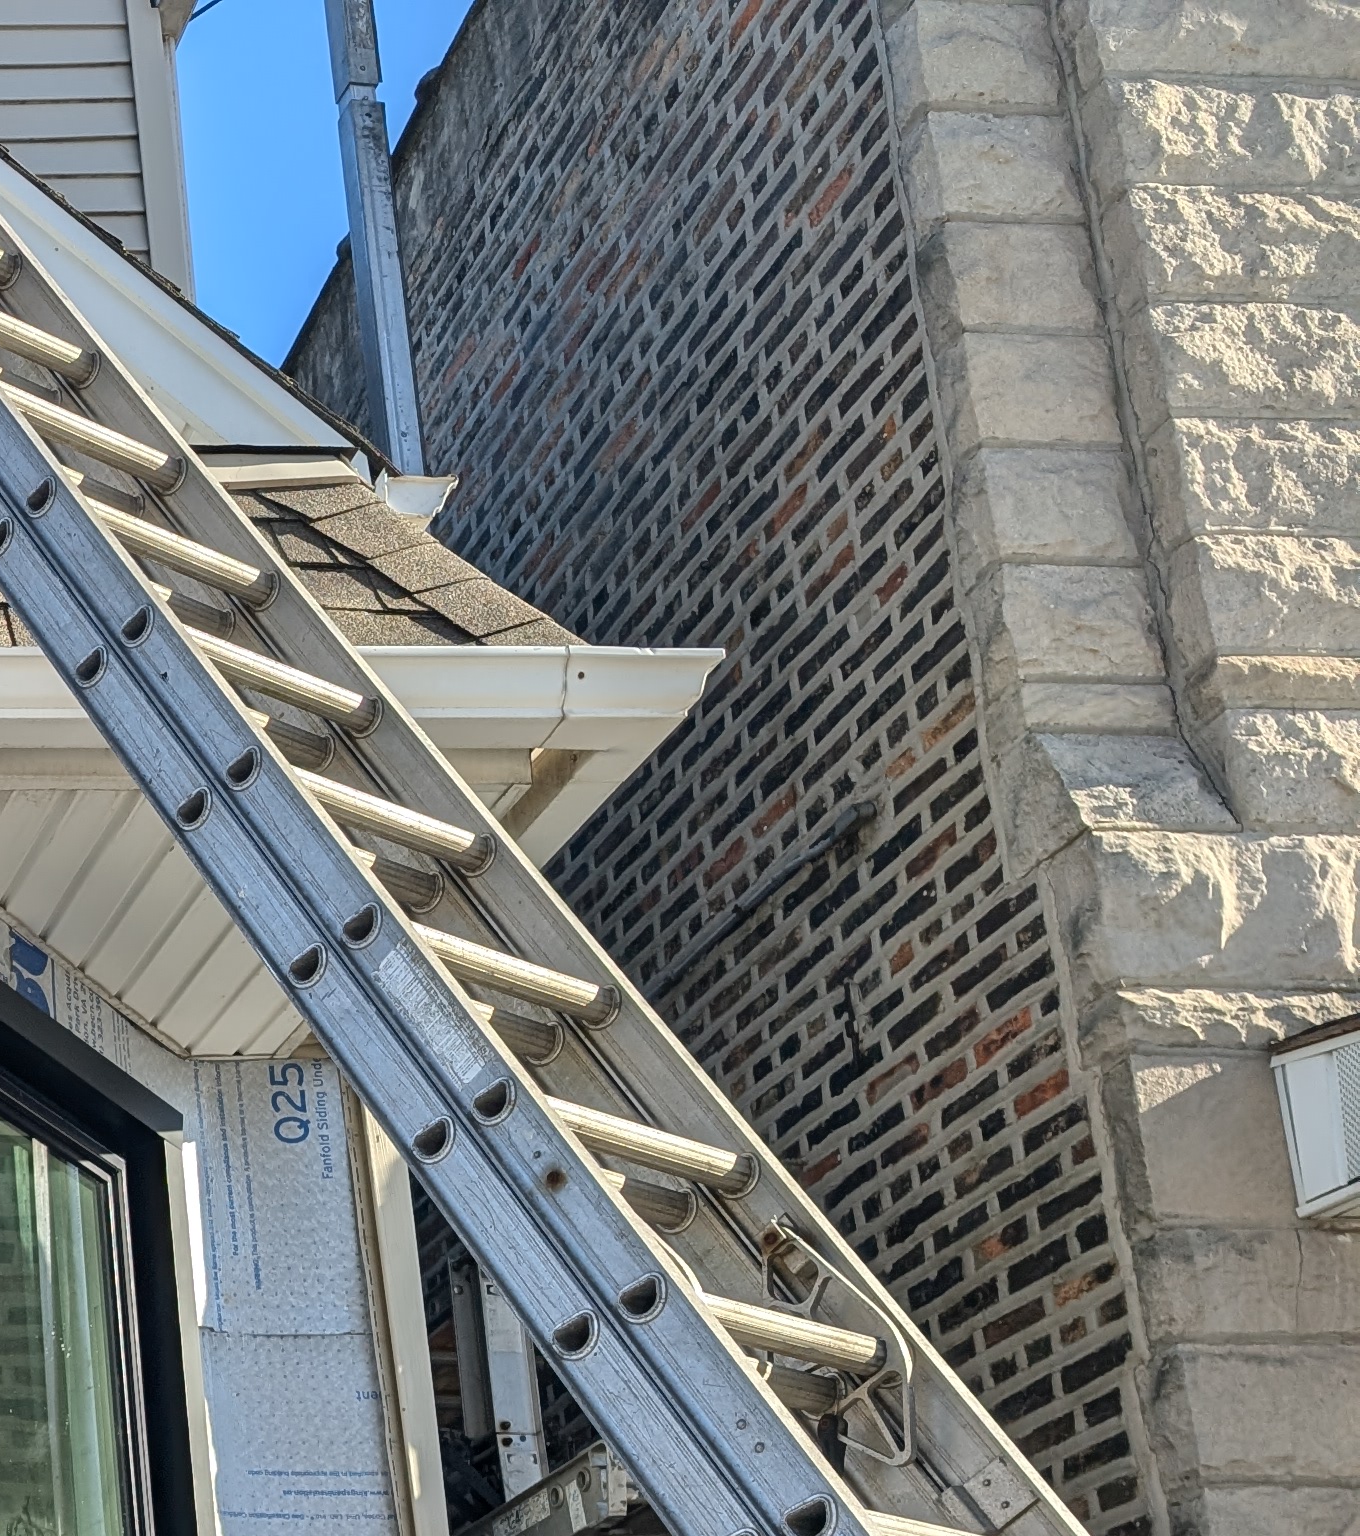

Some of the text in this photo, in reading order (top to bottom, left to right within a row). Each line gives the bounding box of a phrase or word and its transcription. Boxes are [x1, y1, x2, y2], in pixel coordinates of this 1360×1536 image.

[268, 1062, 311, 1144] Q25
[315, 1091, 333, 1180] Fanfold Siding
